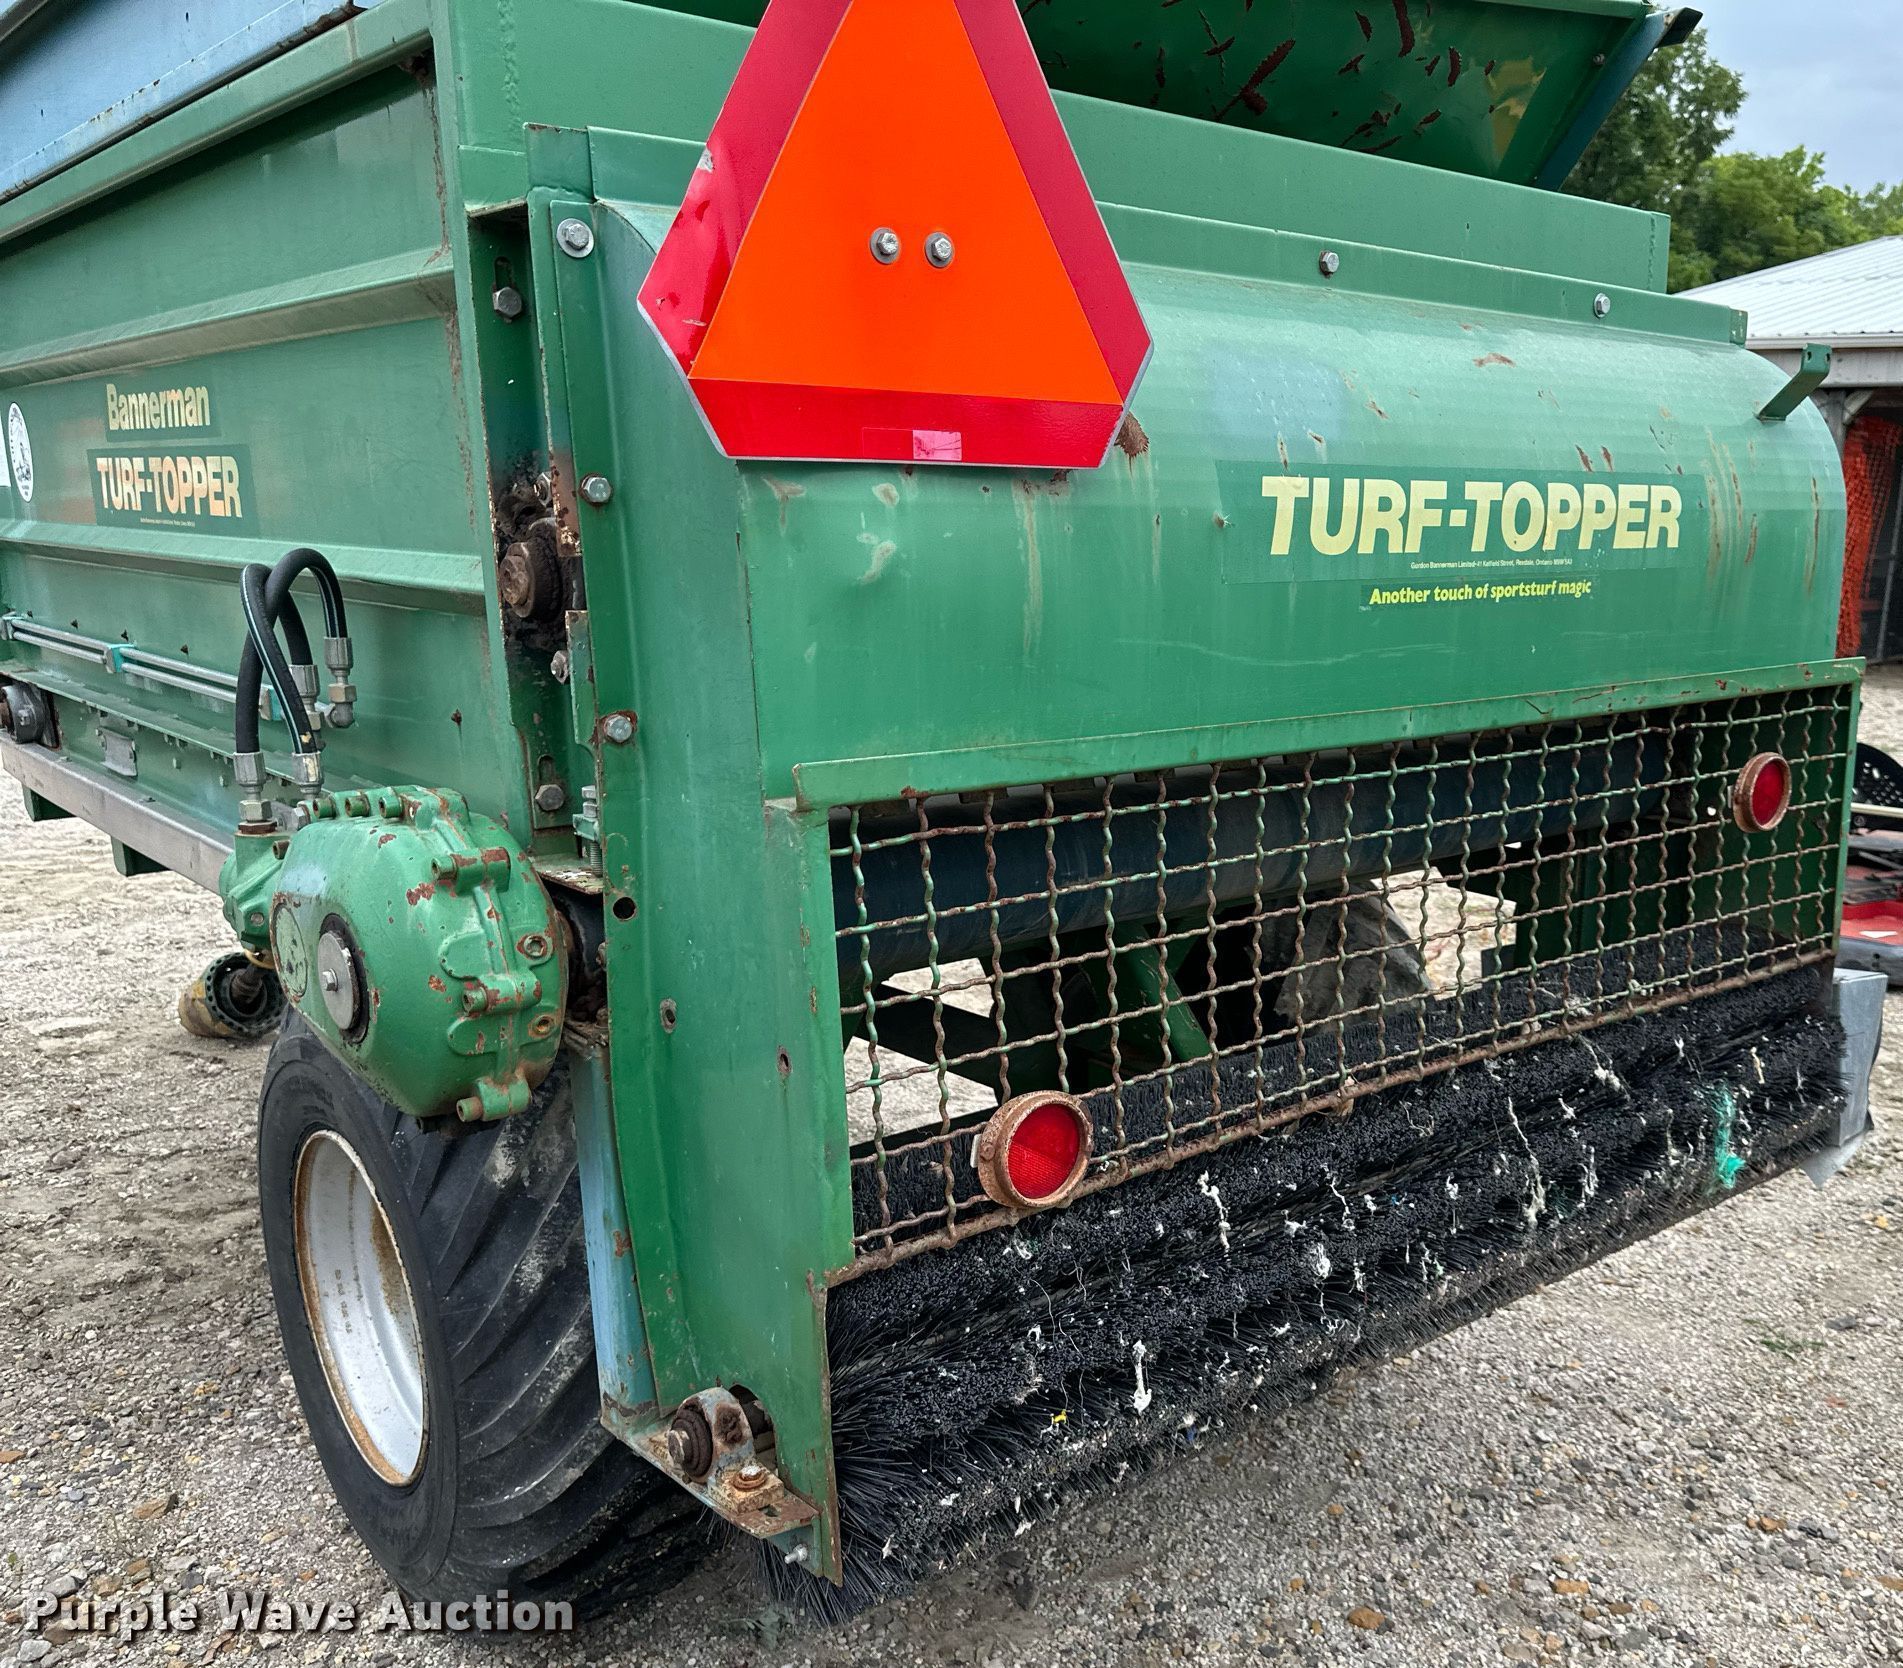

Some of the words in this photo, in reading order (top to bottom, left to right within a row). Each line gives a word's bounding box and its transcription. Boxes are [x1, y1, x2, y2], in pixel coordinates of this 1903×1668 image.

[106, 383, 211, 431] Bannerman
[96, 455, 243, 518] TURF-TOPPER
[1261, 476, 1682, 556] TURF-TOPPER
[1369, 587, 1430, 605] Another
[1434, 584, 1472, 601] touch
[1475, 583, 1489, 599] of
[1490, 580, 1557, 603] sportsturf
[1558, 579, 1592, 598] magic
